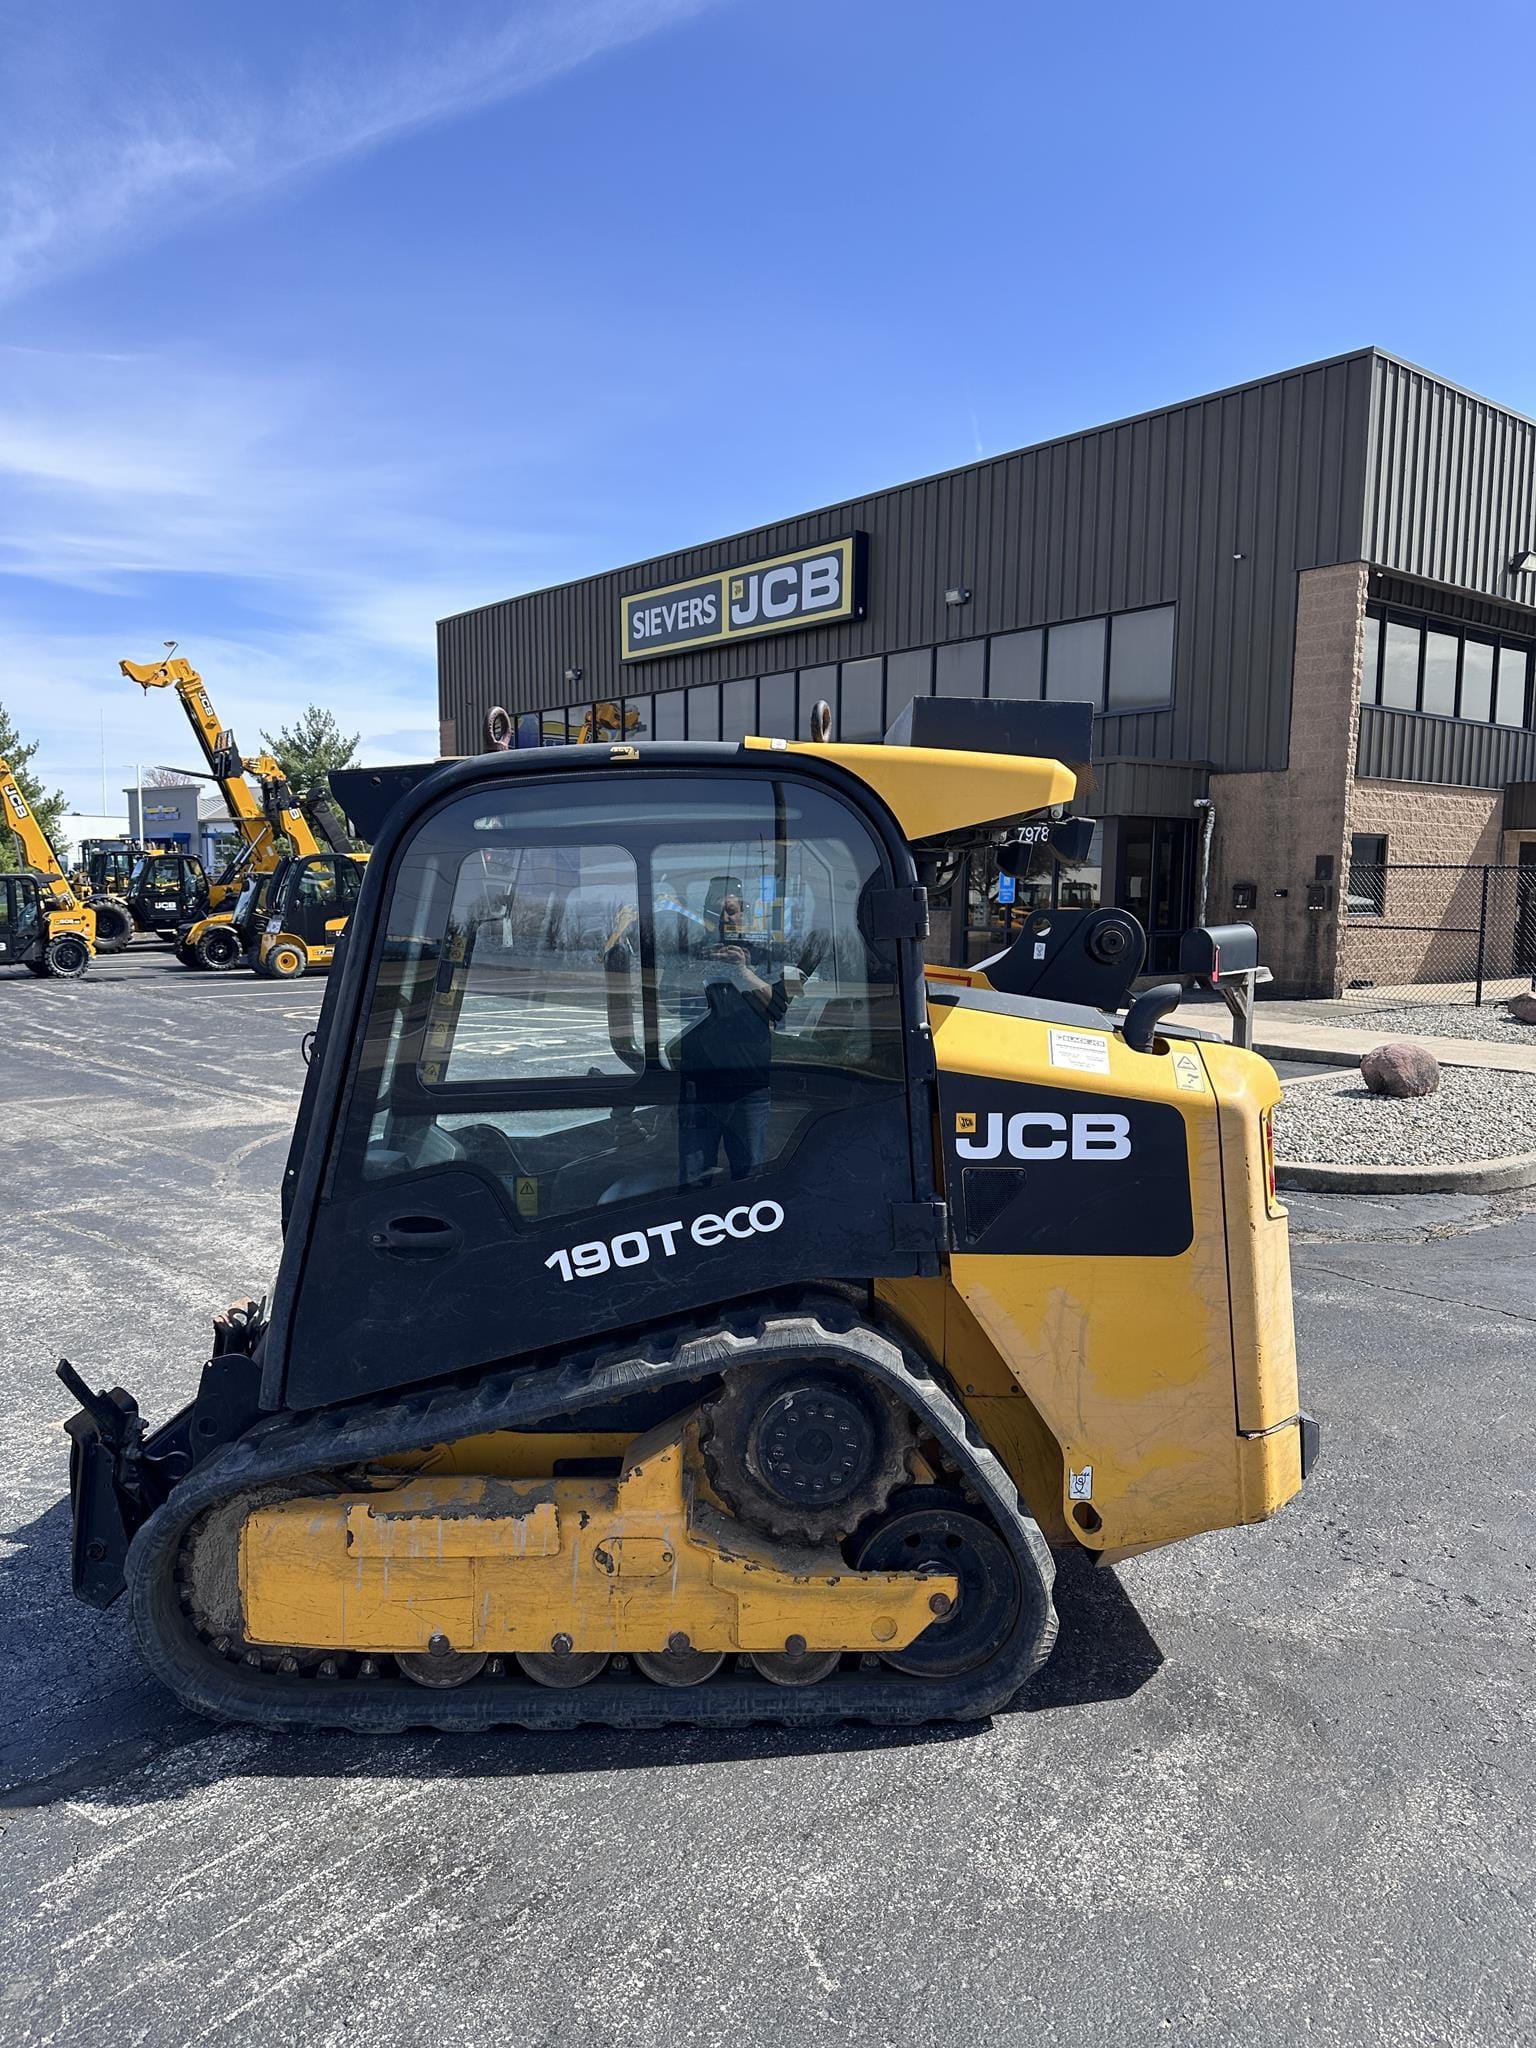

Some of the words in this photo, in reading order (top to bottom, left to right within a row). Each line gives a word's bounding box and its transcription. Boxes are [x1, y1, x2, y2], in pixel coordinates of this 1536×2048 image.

[632, 593, 717, 640] SIEVERS
[731, 555, 840, 625] JCB
[198, 691, 214, 717] JCB
[4, 784, 29, 819] JCB
[1017, 826, 1050, 842] 7978
[955, 1112, 1132, 1161] JCB
[544, 1220, 684, 1282] 190T
[690, 1199, 785, 1247] eco
